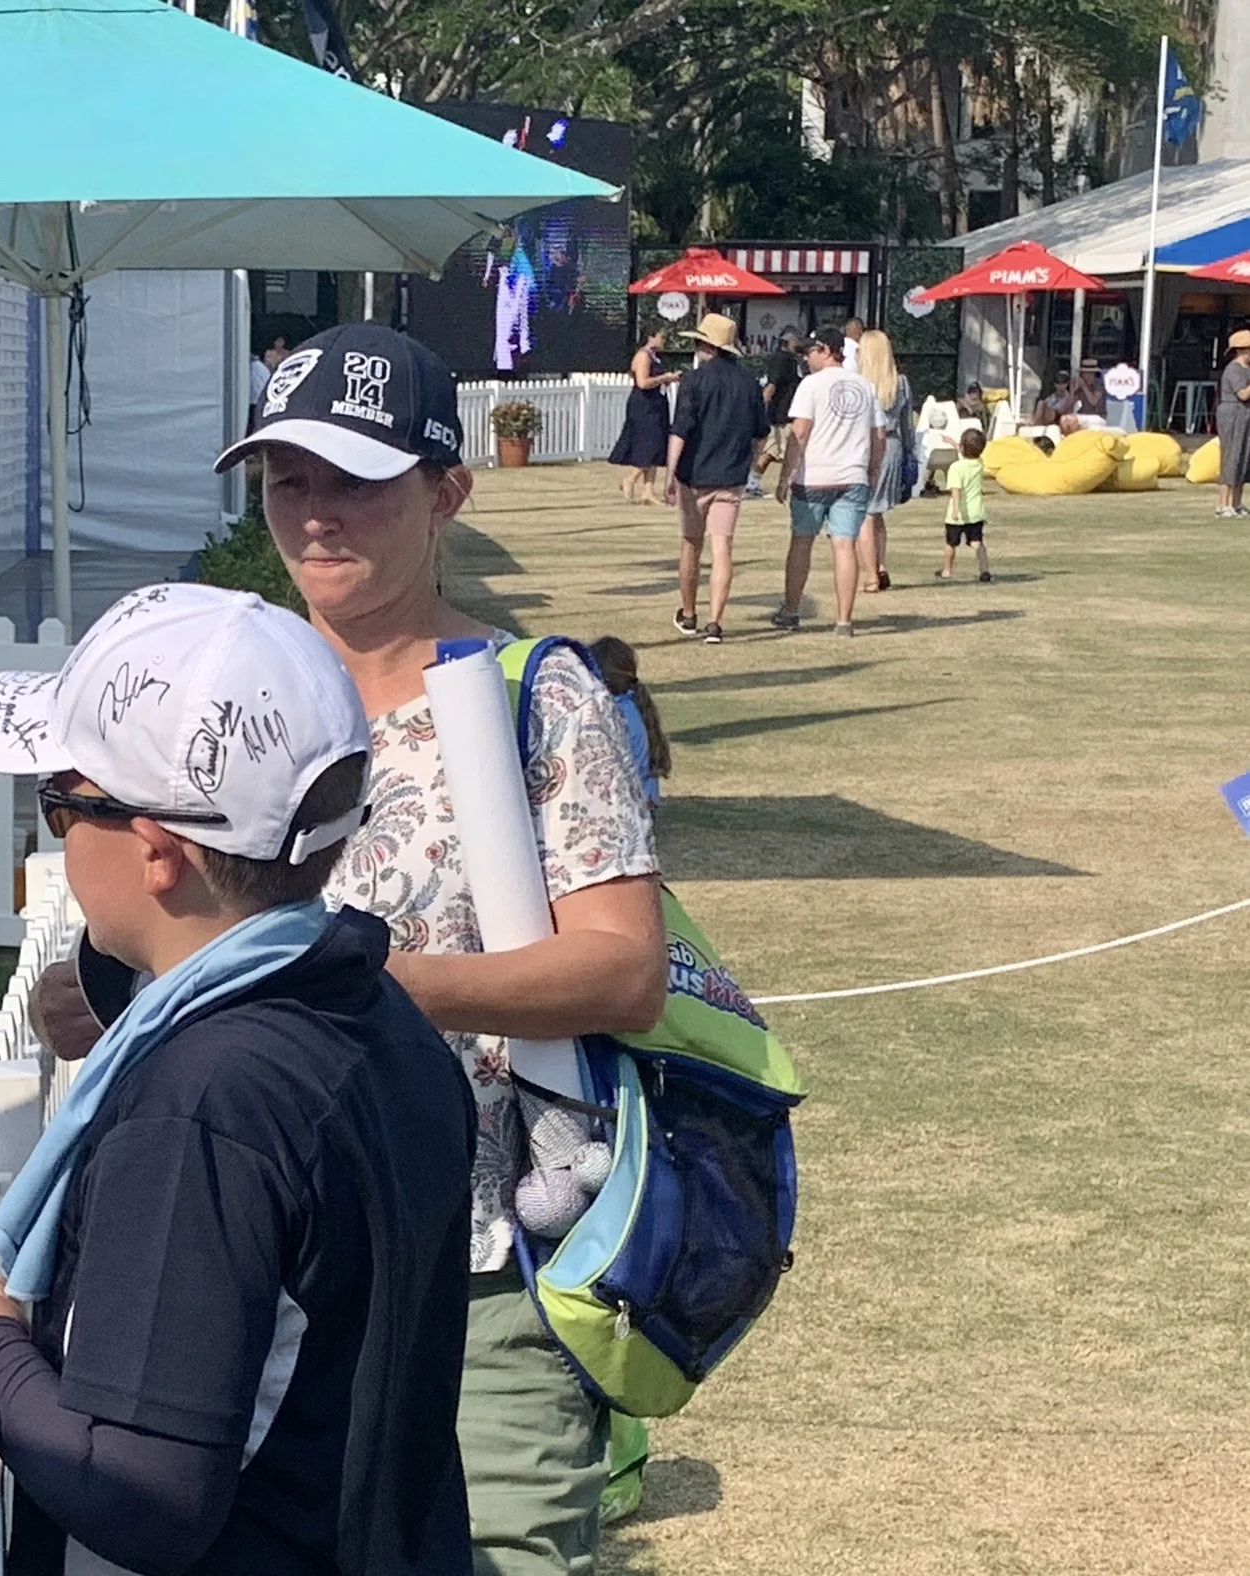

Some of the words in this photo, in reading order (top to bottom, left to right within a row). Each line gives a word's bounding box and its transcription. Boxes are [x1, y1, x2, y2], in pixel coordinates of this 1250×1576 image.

[685, 273, 739, 288] PIMM'S
[989, 267, 1050, 284] PIMM'S
[343, 351, 391, 384] 20
[345, 375, 384, 410] 14
[331, 400, 394, 429] MEMBER
[668, 941, 695, 968] ab
